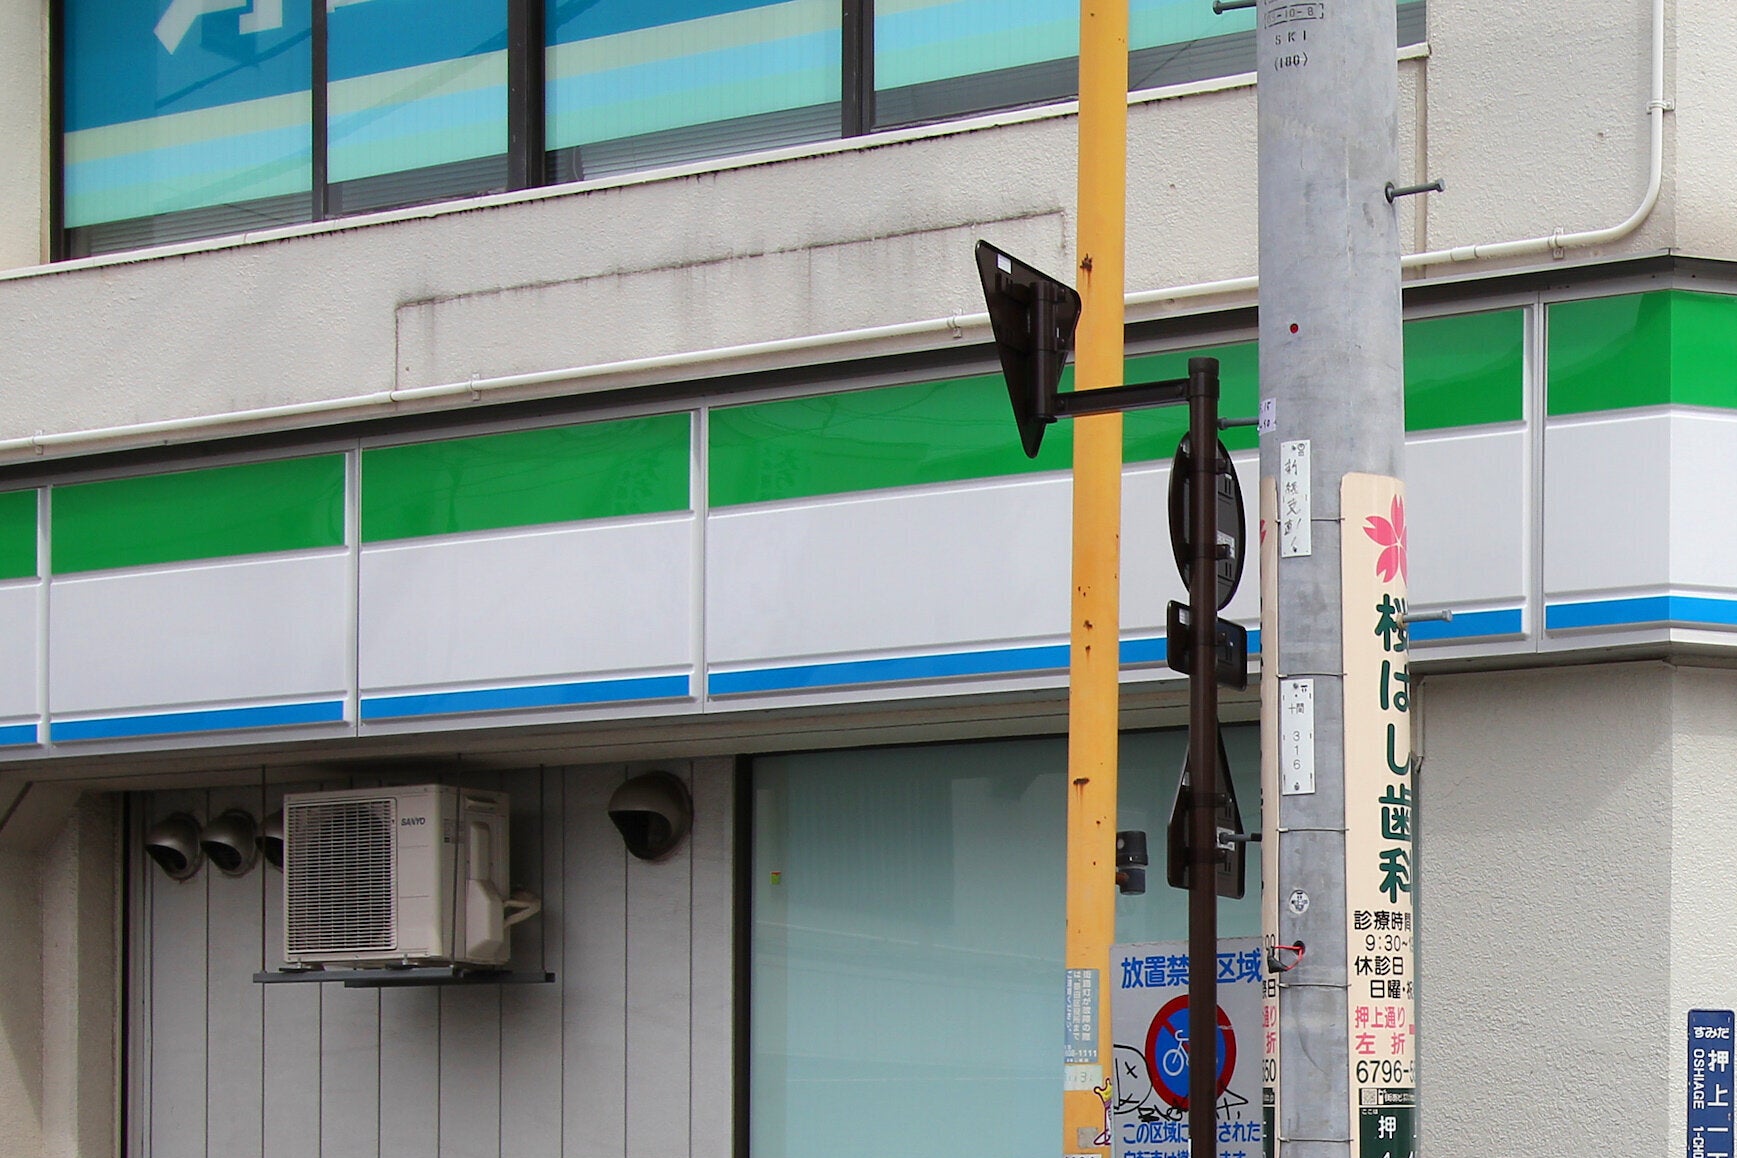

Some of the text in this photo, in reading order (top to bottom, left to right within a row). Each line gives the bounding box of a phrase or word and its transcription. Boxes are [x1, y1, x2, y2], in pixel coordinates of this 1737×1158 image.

[400, 817, 426, 826] SANYO
[1354, 910, 1412, 931] 診療時間
[1121, 948, 1262, 989] 放置禁区域
[1354, 956, 1404, 976] 休診日
[1355, 1006, 1406, 1029] 押上通り
[1693, 1026, 1730, 1039] すみだ
[1692, 1048, 1705, 1110] OSHIAGE
